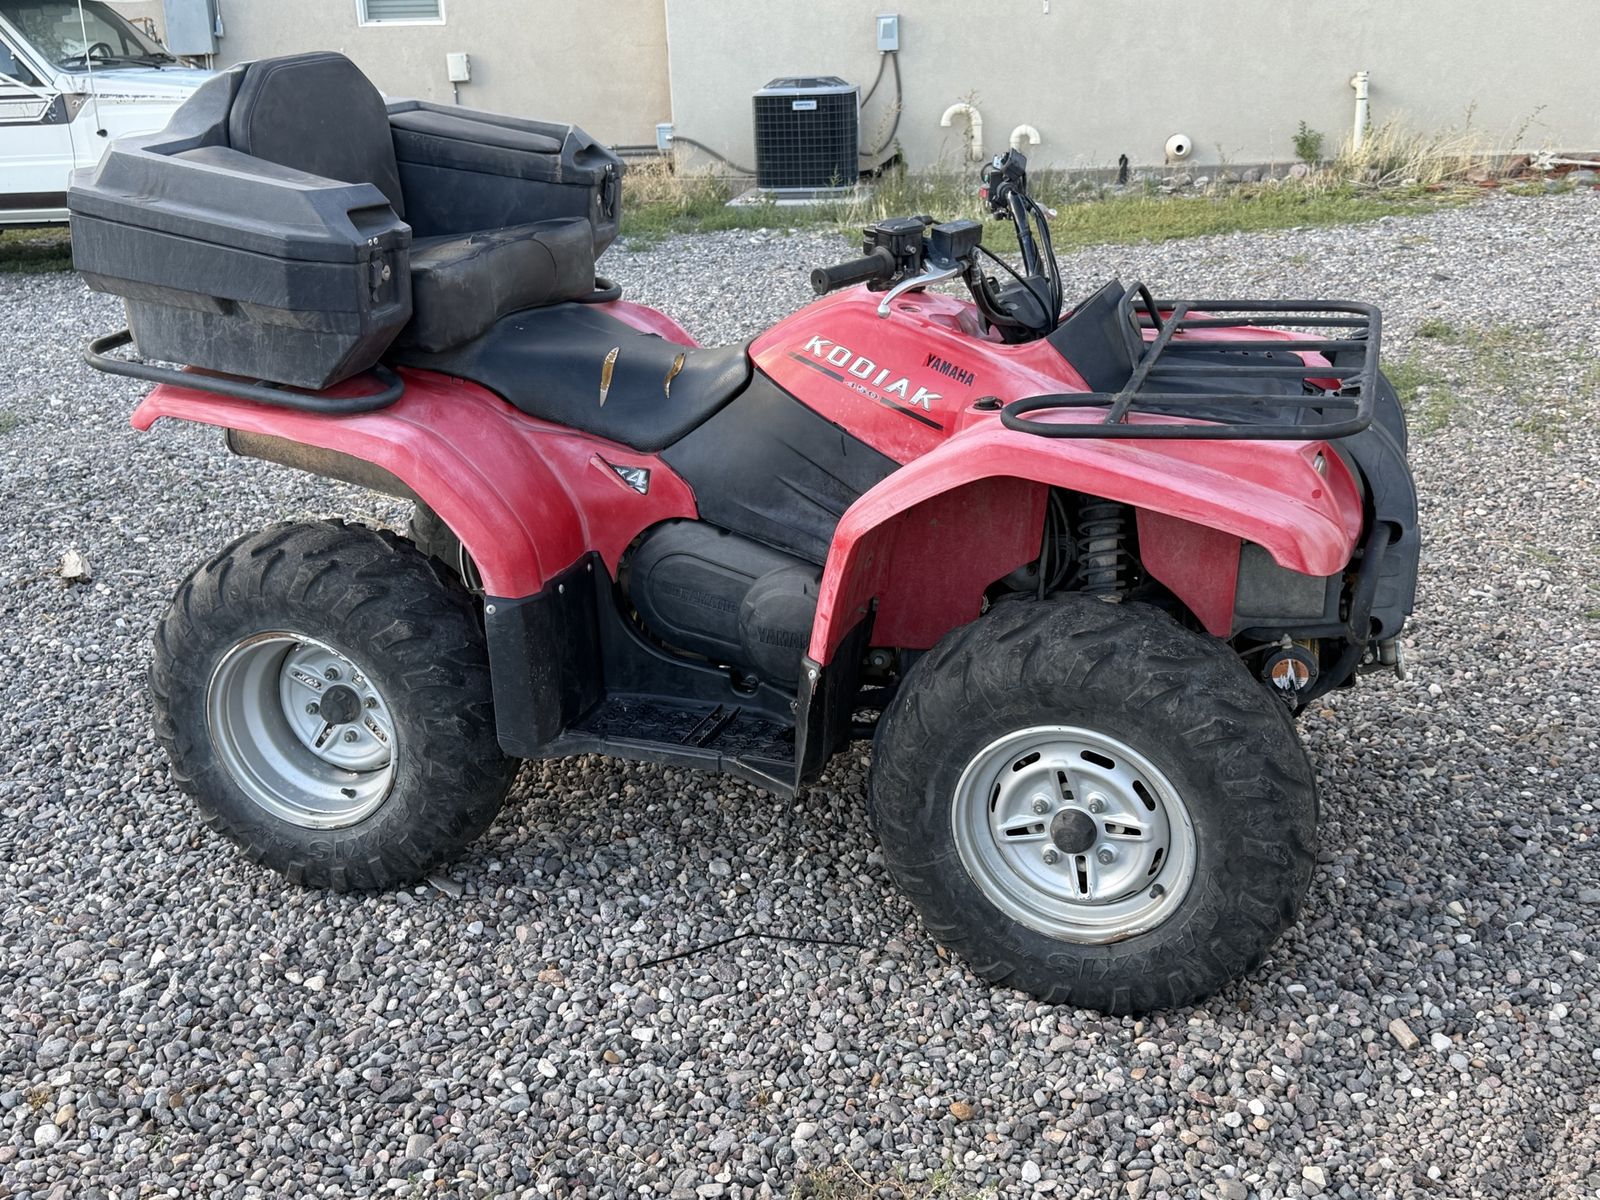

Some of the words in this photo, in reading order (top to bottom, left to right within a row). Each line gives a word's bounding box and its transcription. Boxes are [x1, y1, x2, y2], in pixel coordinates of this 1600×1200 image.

[803, 335, 943, 411] KODIAK
[925, 353, 976, 387] YAMAHA
[757, 626, 809, 650] YAMAH
